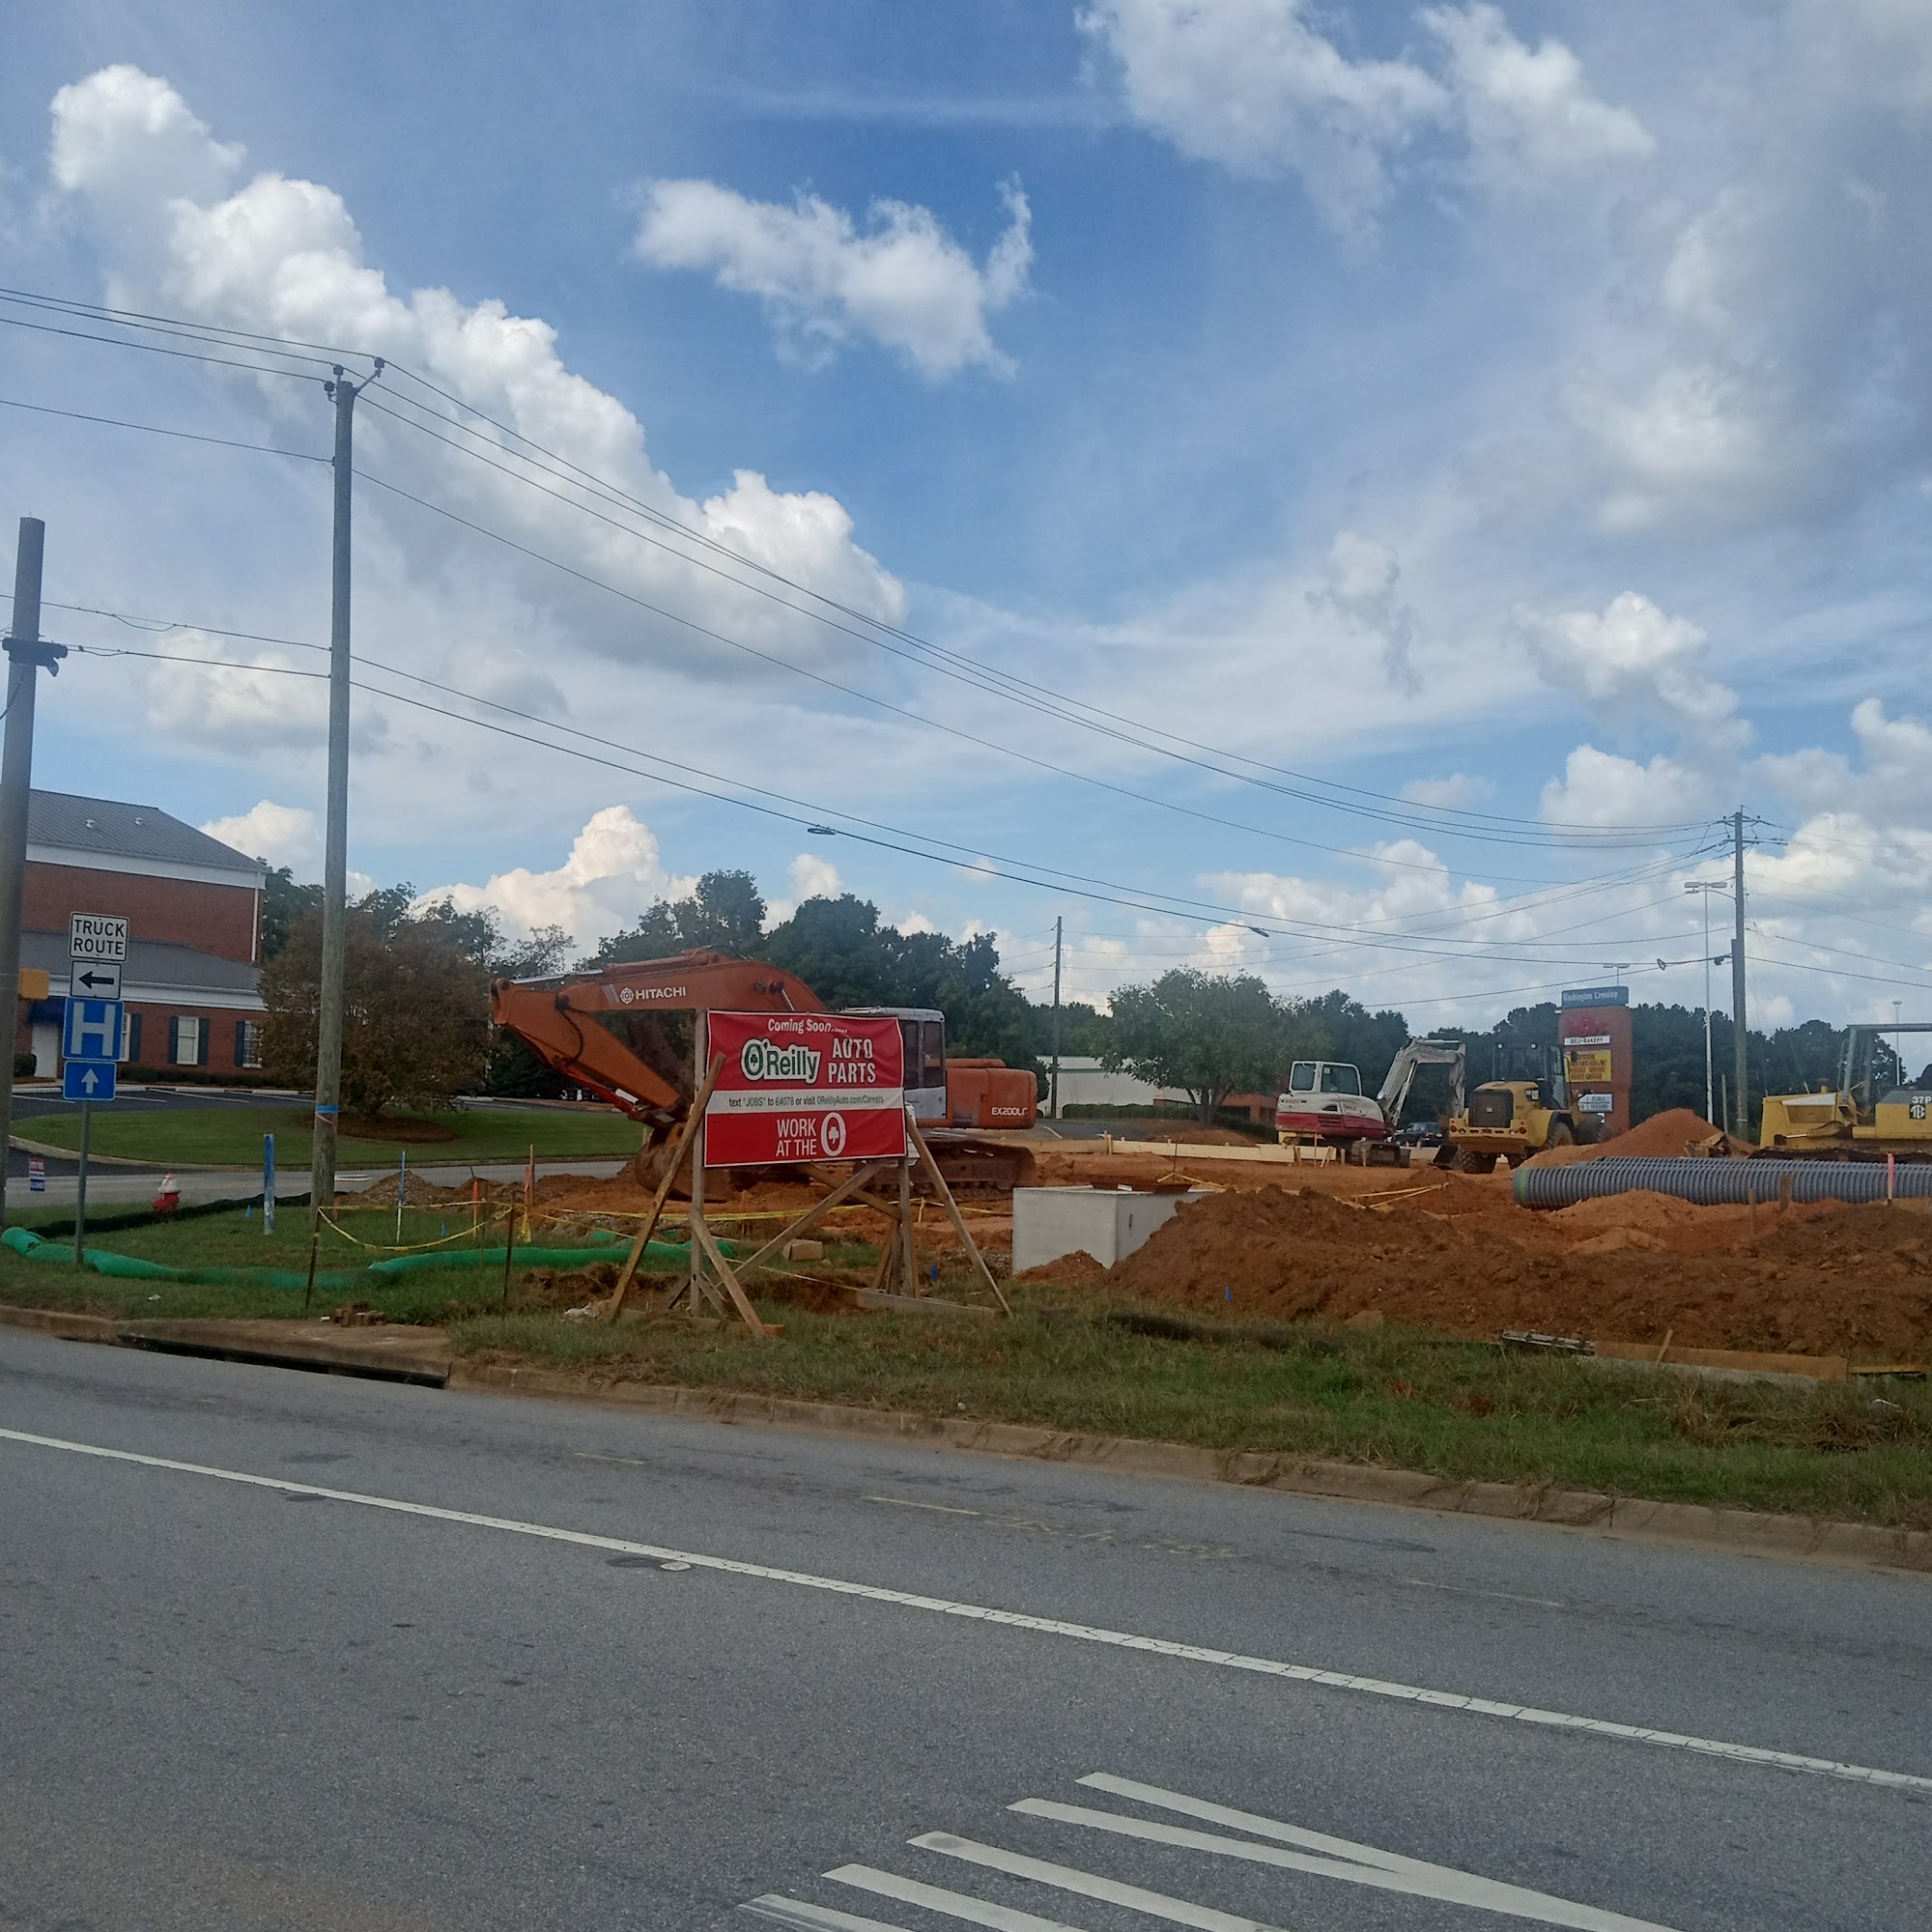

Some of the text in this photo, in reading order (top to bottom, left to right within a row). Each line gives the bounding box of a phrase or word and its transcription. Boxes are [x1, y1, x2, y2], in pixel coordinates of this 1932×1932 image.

[74, 919, 125, 938] TRUCK
[73, 937, 124, 955] ROUTE
[636, 986, 687, 1001] HITACHI
[71, 1001, 116, 1057] H
[768, 1018, 804, 1035] Coming
[832, 1037, 873, 1060] AUTO
[743, 1040, 819, 1081] O'Reilly
[828, 1062, 876, 1084] PARTS
[729, 1097, 741, 1107] text
[768, 1097, 774, 1107] to
[776, 1095, 795, 1106] 64078
[796, 1097, 802, 1106] or
[804, 1096, 815, 1106] visit
[777, 1118, 816, 1138] WORK
[776, 1138, 817, 1157] AT THE
